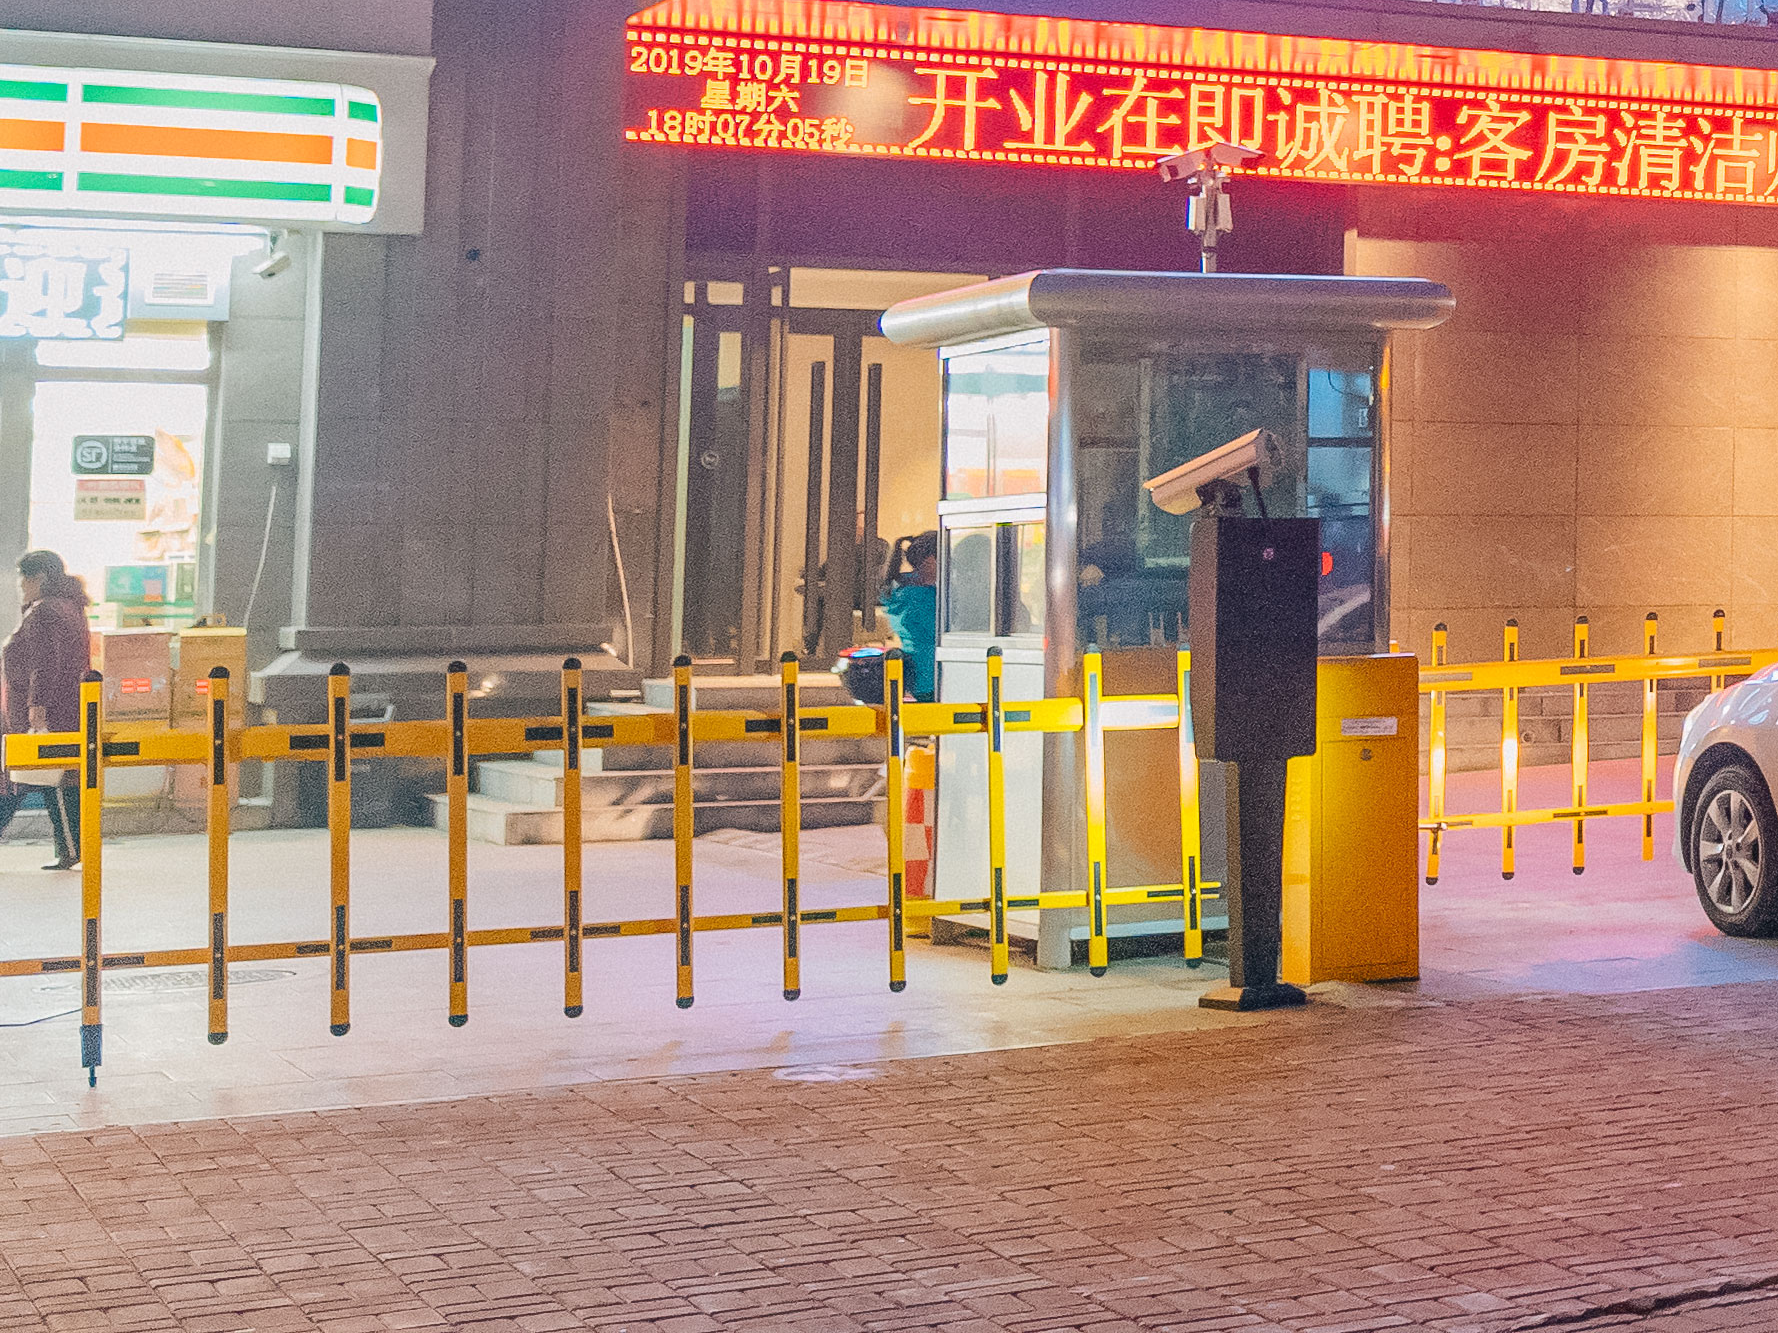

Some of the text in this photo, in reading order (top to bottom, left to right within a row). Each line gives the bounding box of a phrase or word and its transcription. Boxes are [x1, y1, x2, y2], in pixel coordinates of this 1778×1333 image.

[630, 46, 869, 88] 2019年10月19日
[700, 79, 801, 113] 星期六
[646, 110, 855, 148] 18时07分05秒
